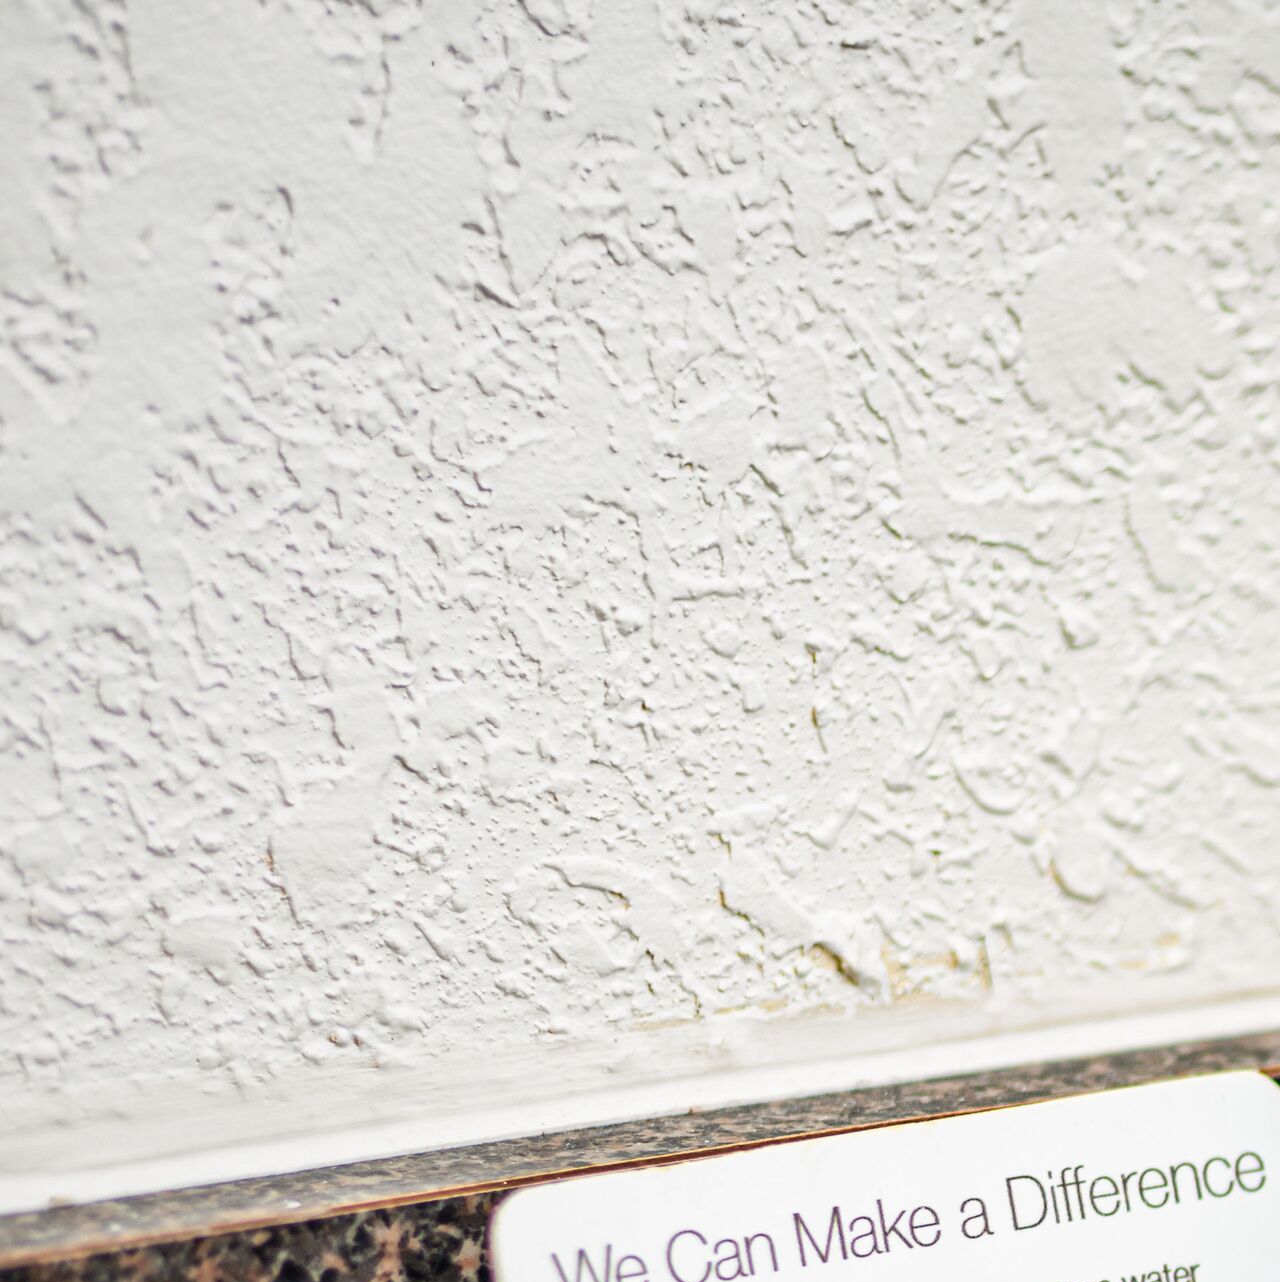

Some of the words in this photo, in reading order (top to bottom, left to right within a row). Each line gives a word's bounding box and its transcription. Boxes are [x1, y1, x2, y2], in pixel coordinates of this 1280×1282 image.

[792, 1199, 942, 1267] Make
[960, 1197, 995, 1239] a
[1005, 1151, 1266, 1231] Difference
